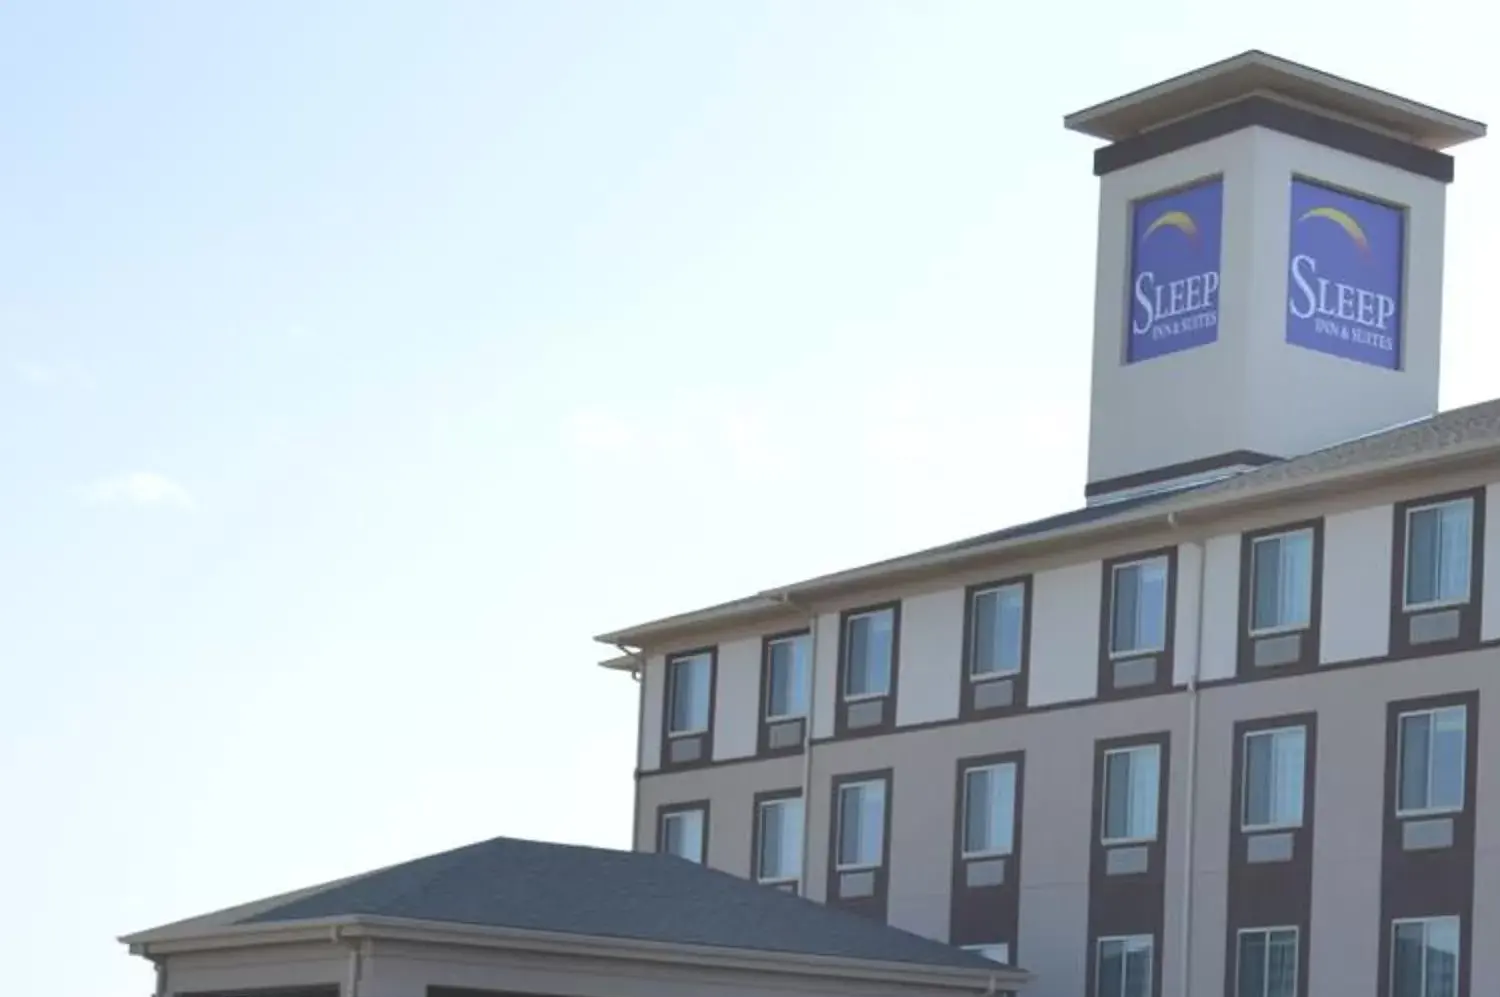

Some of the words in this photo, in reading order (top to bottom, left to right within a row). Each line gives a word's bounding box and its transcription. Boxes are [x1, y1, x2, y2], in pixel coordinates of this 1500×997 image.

[1133, 271, 1218, 336] SLEEP
[1290, 254, 1395, 330] SLEEP
[1314, 318, 1339, 336] INN
[1352, 327, 1393, 351] SUITES
